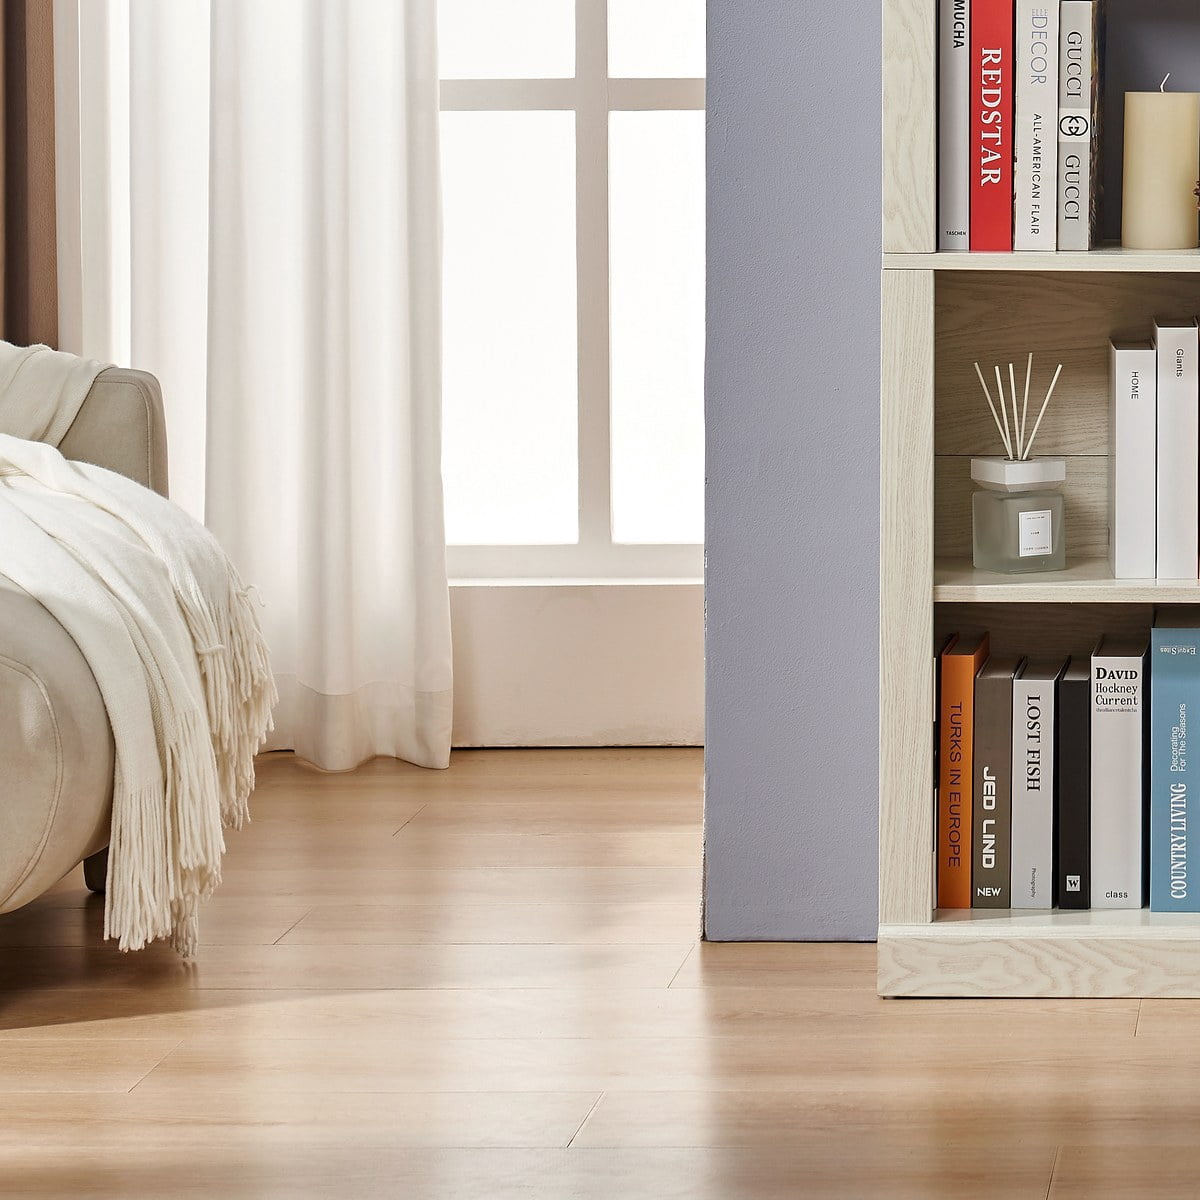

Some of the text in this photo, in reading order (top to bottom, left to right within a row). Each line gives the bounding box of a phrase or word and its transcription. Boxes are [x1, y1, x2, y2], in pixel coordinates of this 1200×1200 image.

[953, 0, 965, 49] MUCHA
[1030, 16, 1047, 85] DECOR
[1066, 31, 1083, 98] GUCCI
[980, 47, 1002, 186] REDSTAR
[1030, 113, 1042, 235] ALL-AMERICAN FLAIR
[1064, 154, 1080, 222] GUCCI
[1130, 371, 1139, 400] HOME
[1175, 348, 1184, 378] Giants
[1095, 667, 1139, 680] DAVID
[1095, 683, 1138, 695] Hockney
[1095, 694, 1139, 706] Current
[1026, 695, 1041, 792] LOST FISH
[1170, 726, 1179, 772] Decorating
[1178, 704, 1187, 772] For The Seasons
[948, 701, 962, 867] TURKS IN EUROPE
[982, 766, 996, 869] JED LIND
[1170, 783, 1187, 899] COUNTRY LIVING
[977, 887, 1001, 896] NEW
[1067, 880, 1079, 888] W
[1105, 890, 1128, 899] class
